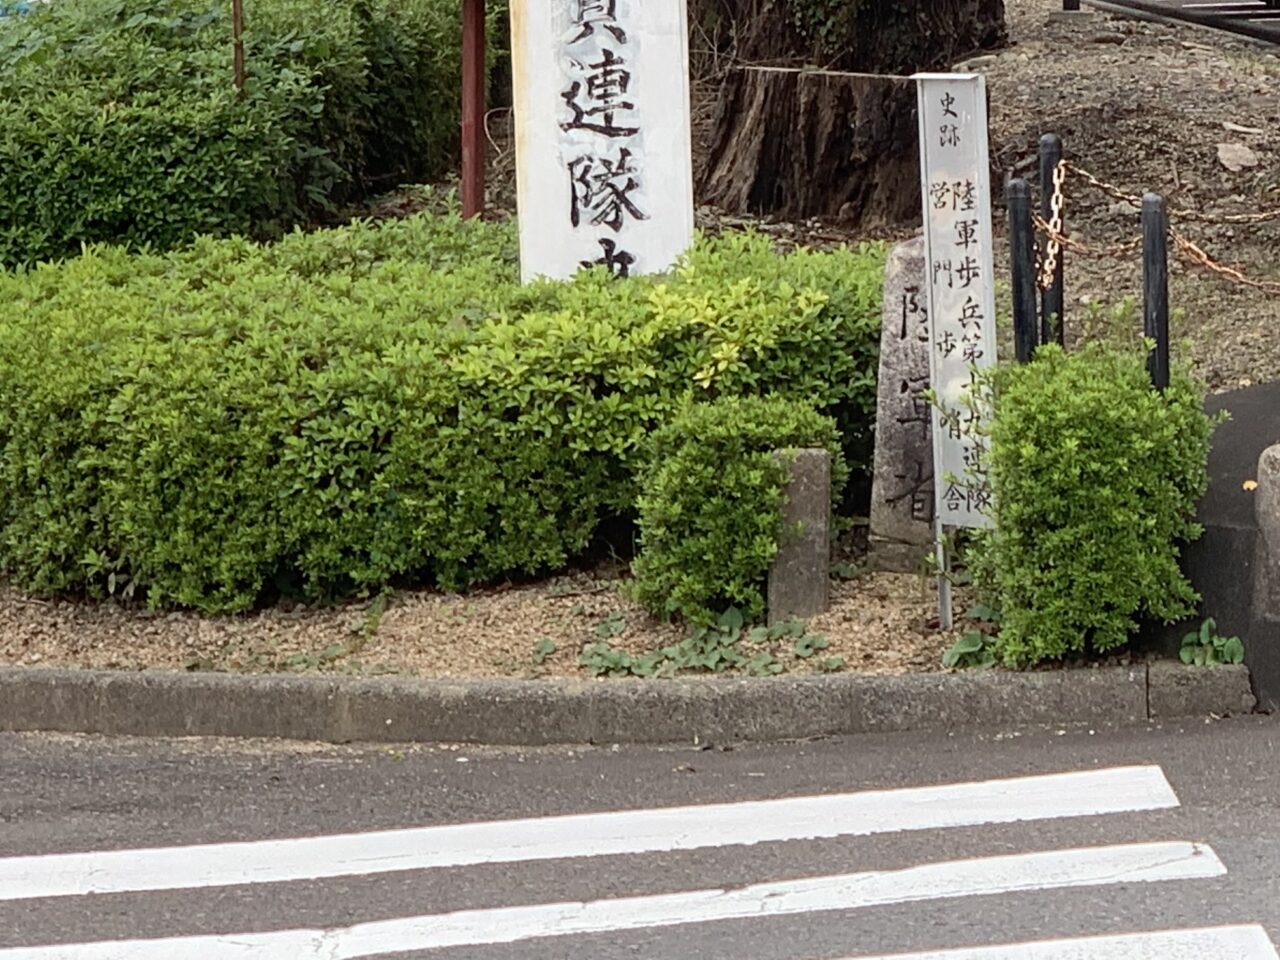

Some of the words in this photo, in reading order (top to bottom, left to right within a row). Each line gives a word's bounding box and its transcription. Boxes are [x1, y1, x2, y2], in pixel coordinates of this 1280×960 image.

[940, 92, 961, 147] 史跡
[929, 181, 966, 511] 営門歩哨舎
